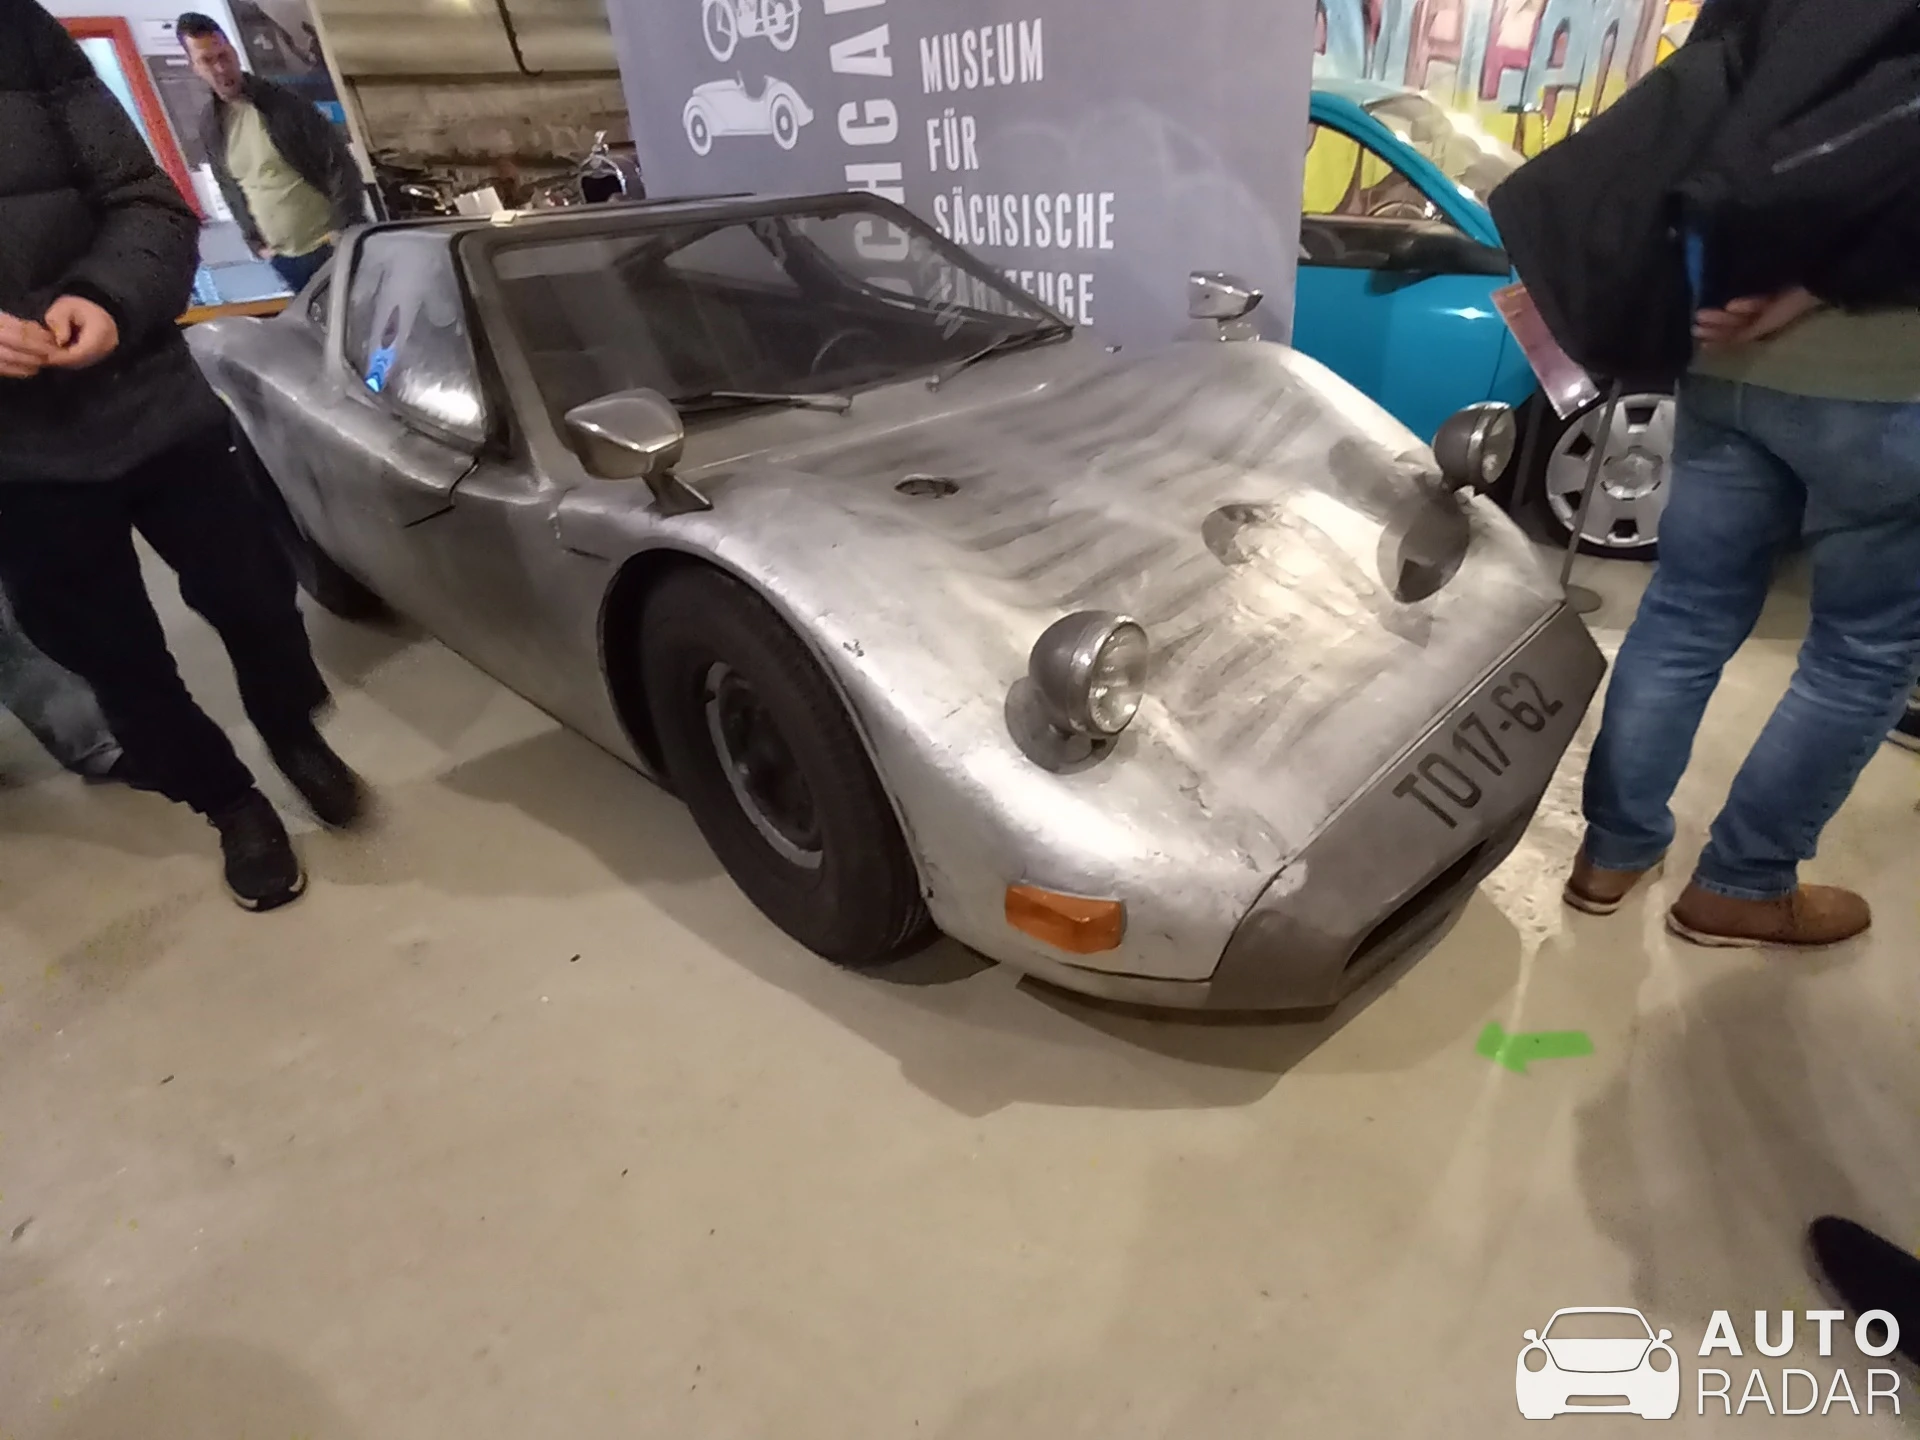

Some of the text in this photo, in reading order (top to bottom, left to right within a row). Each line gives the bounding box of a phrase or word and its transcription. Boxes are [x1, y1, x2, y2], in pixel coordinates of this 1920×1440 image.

[919, 18, 1044, 94] MUSEUM
[926, 107, 979, 172] FÜR
[933, 186, 1115, 249] SÄCHSISCHE
[1452, 671, 1564, 777] 17-62
